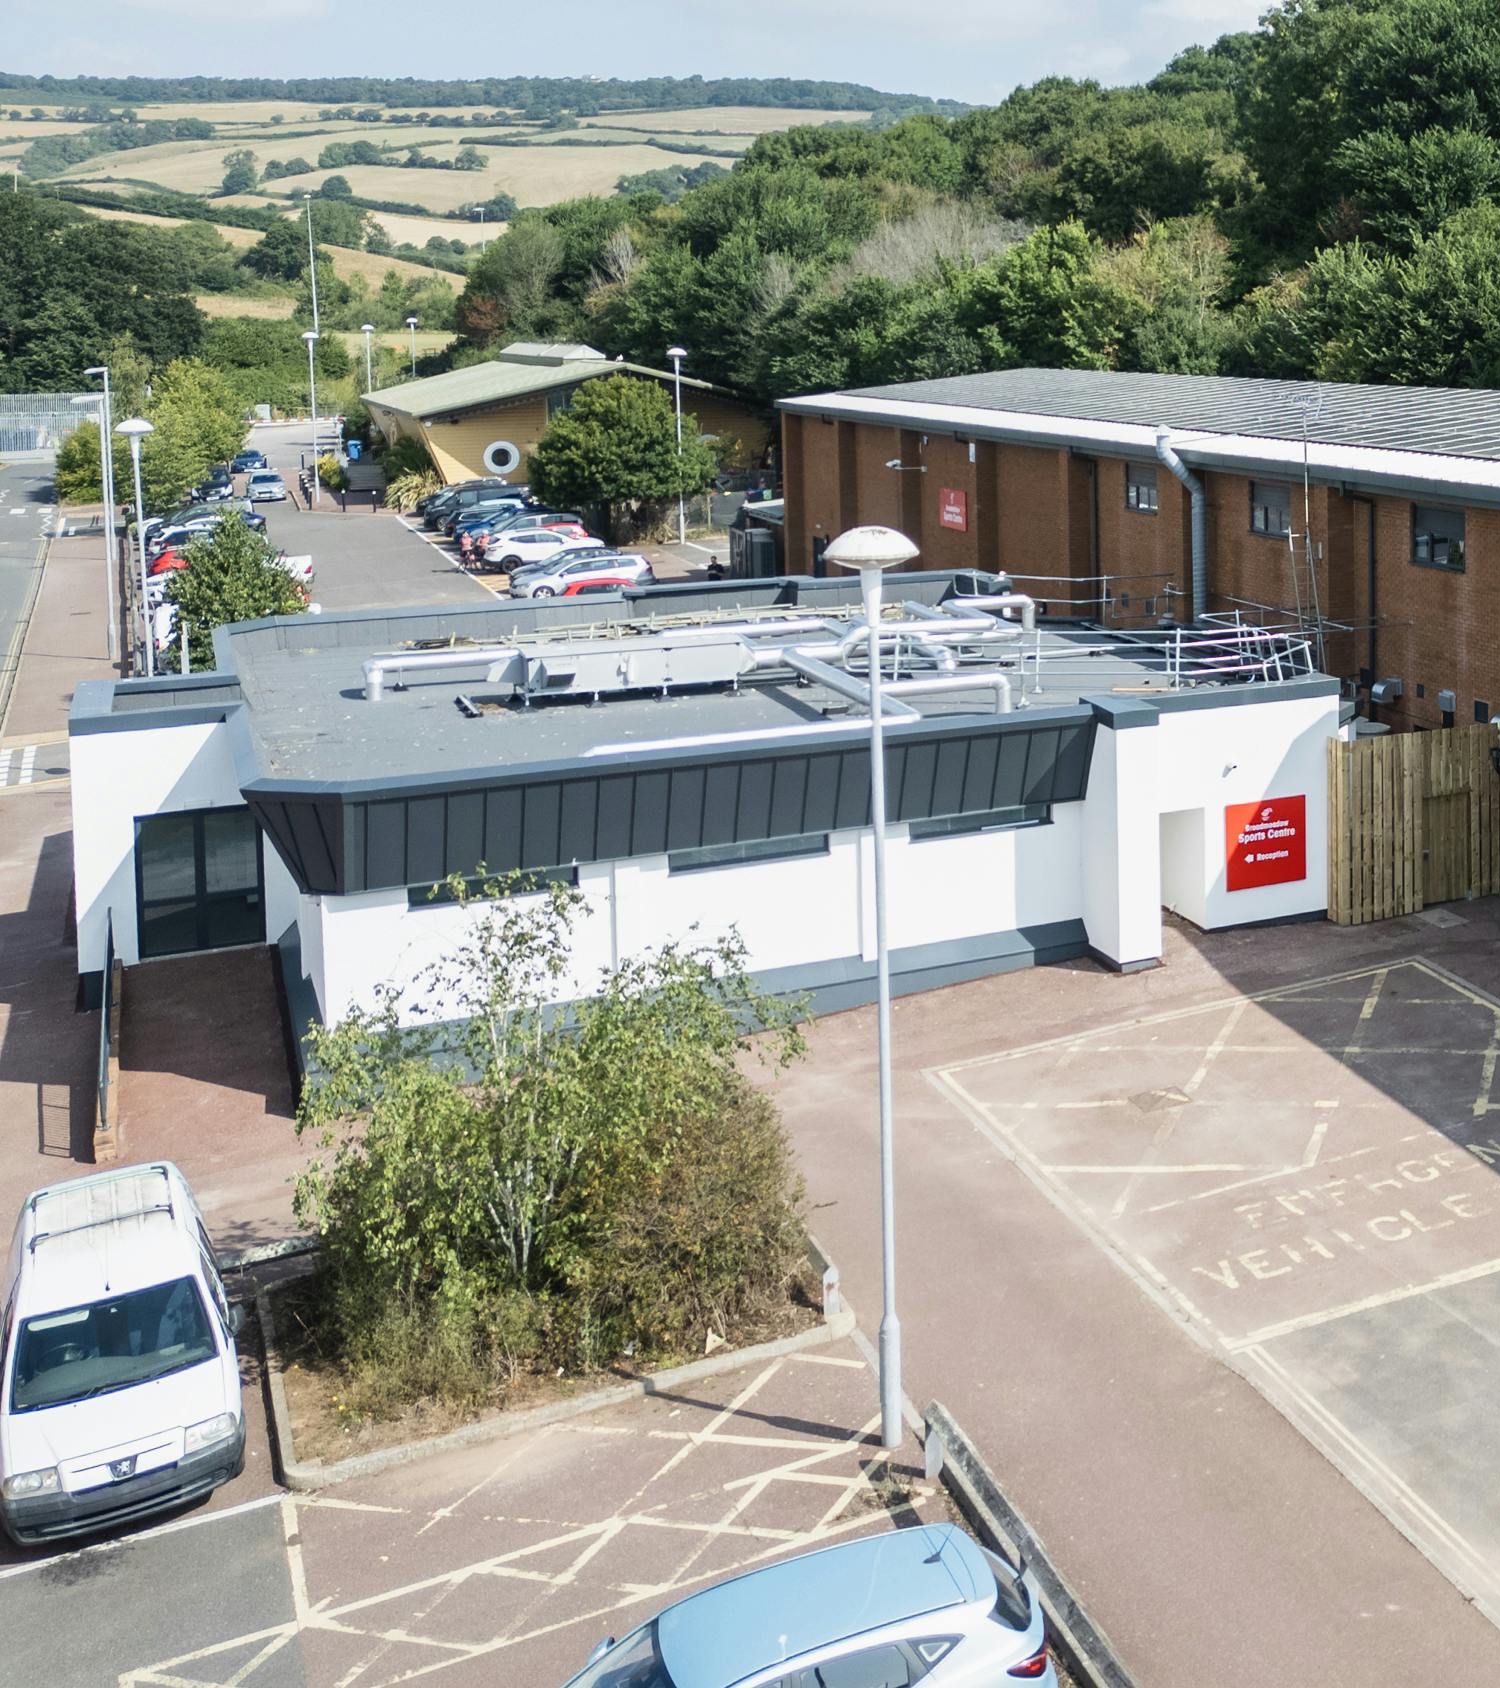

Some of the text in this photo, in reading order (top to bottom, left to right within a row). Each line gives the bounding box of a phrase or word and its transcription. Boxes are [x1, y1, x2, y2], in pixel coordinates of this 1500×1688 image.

[1238, 827, 1295, 844] Sports Centre
[1256, 850, 1289, 861] Reception
[1192, 1193, 1494, 1290] VEHICLE
